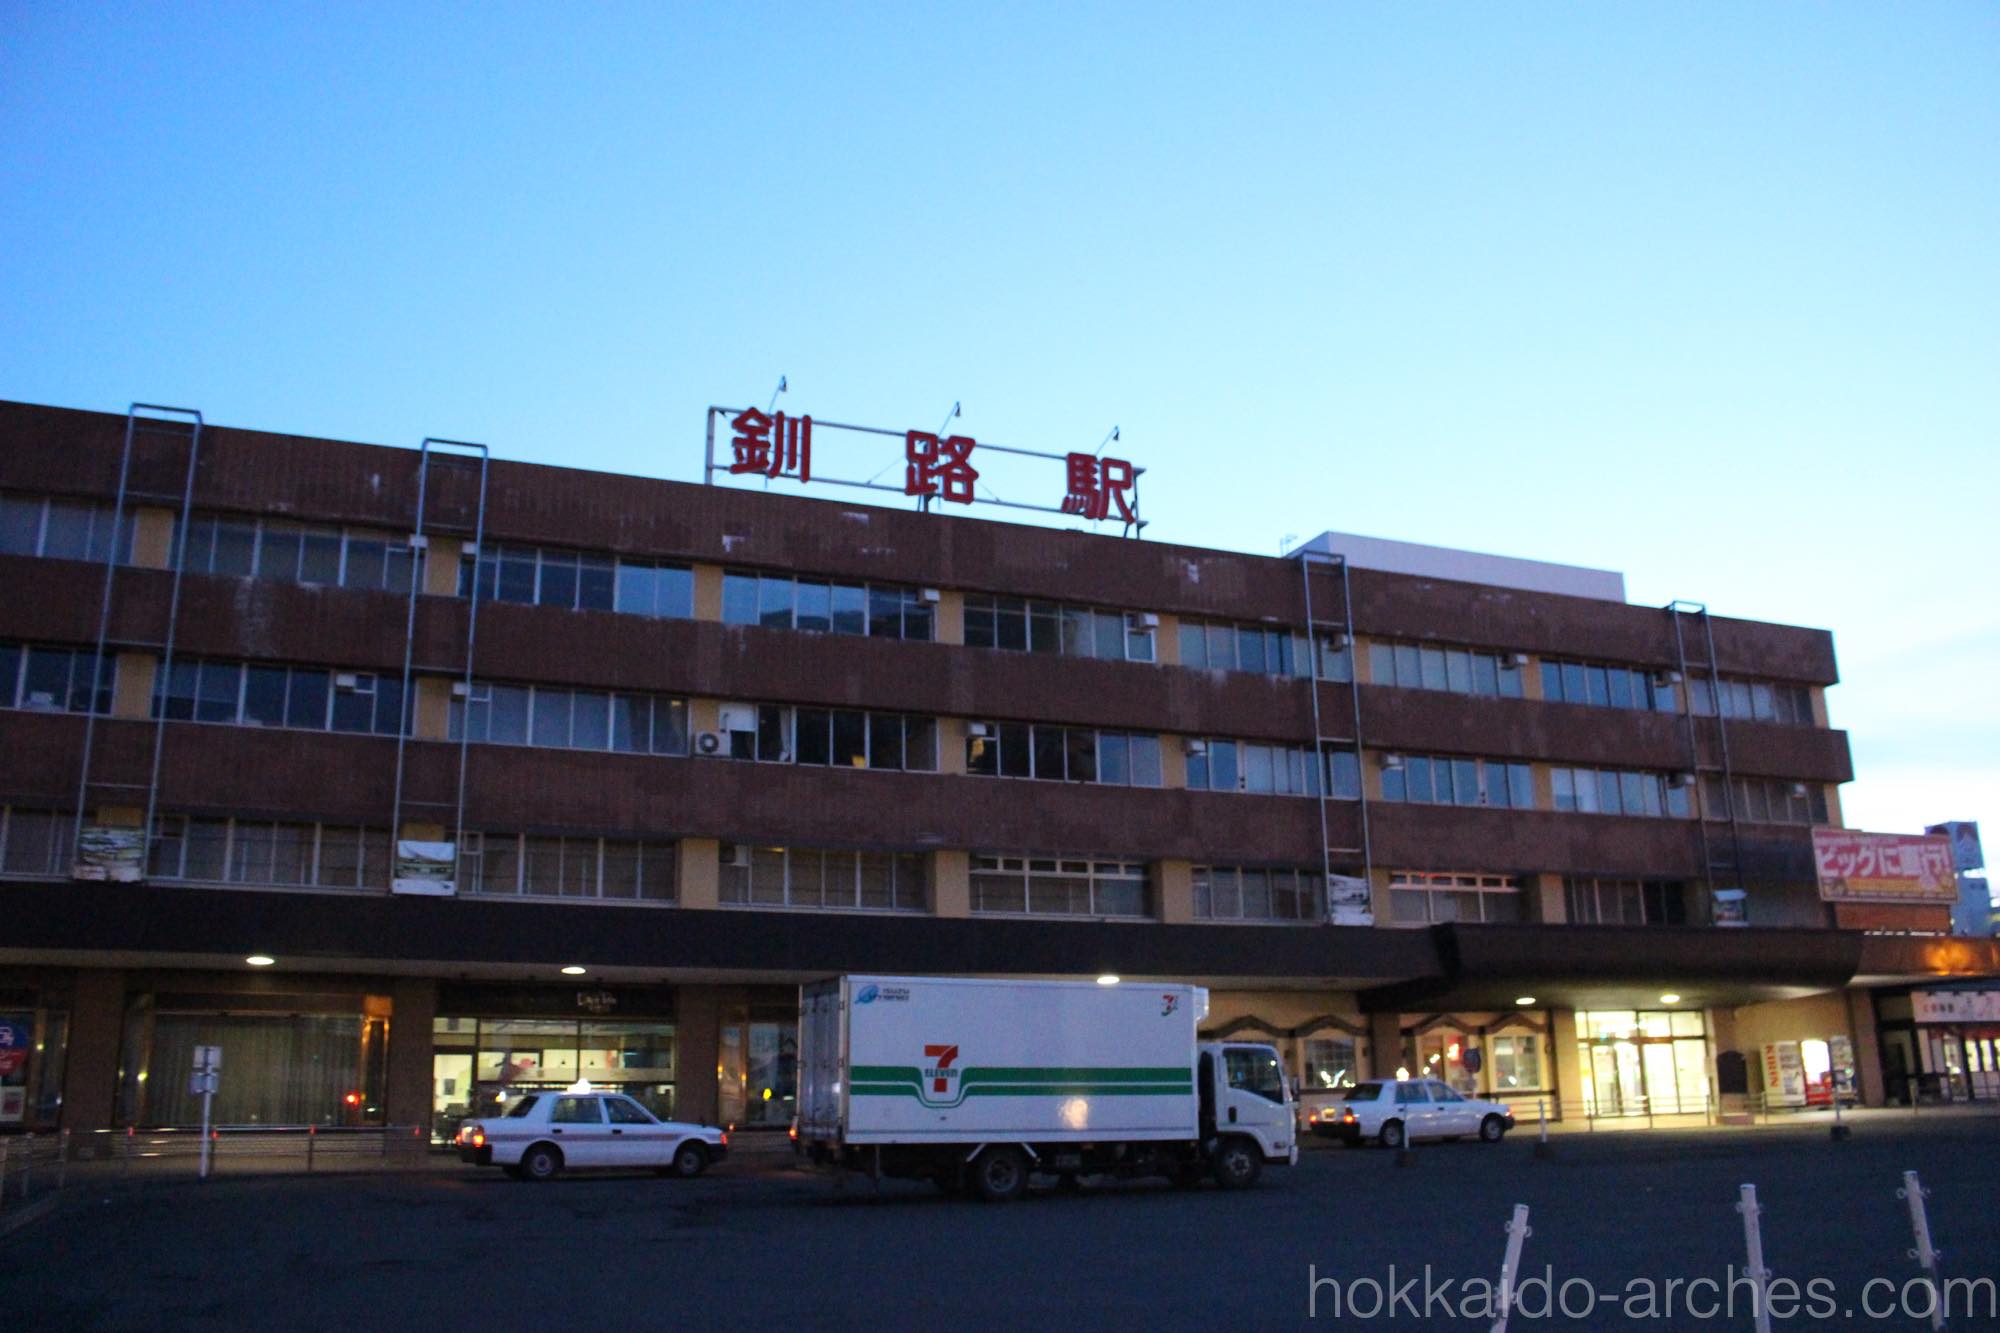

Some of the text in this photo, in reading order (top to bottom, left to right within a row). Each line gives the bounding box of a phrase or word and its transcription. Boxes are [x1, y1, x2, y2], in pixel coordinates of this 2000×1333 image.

[730, 406, 1136, 524] 釧路駅
[1766, 1044, 1779, 1088] KIRIN
